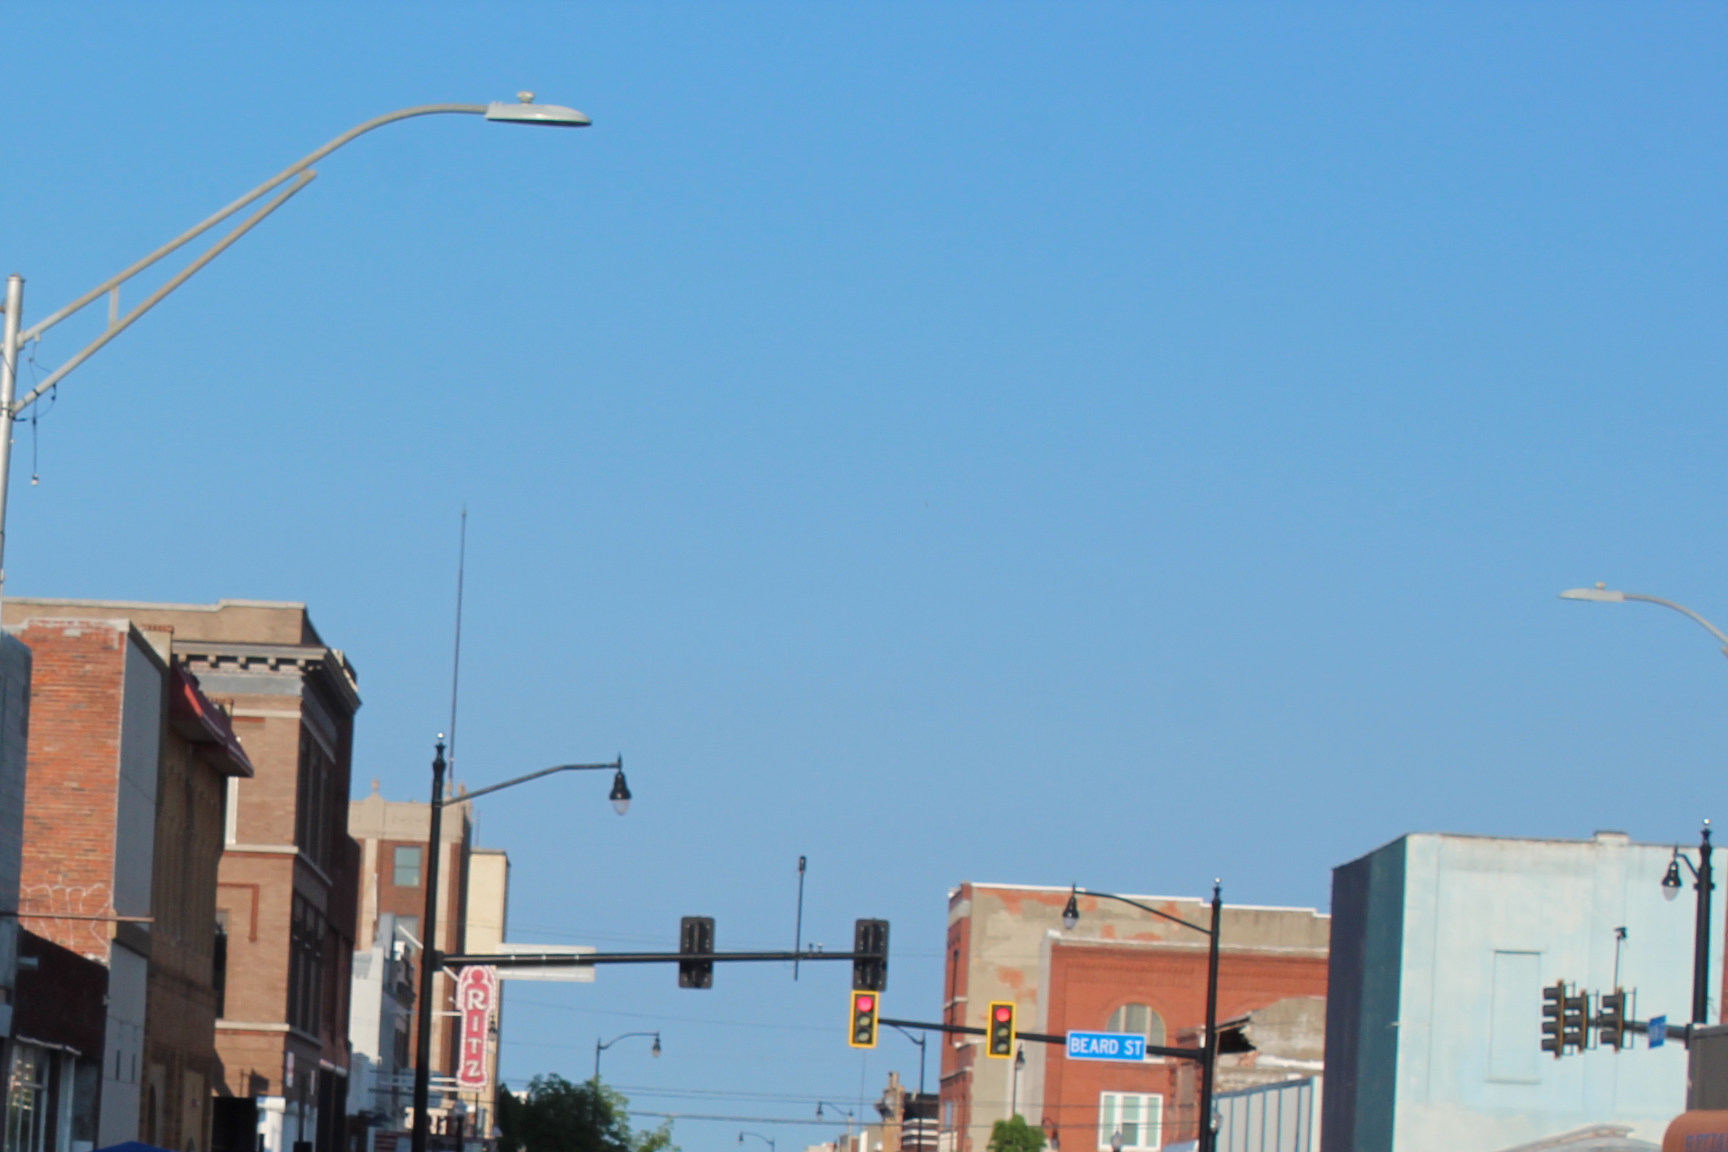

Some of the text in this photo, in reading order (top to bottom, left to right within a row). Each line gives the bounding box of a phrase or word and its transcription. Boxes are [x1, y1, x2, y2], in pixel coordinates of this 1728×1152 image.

[466, 989, 489, 1078] RITZ
[1071, 1037, 1143, 1056] BEARD ST
